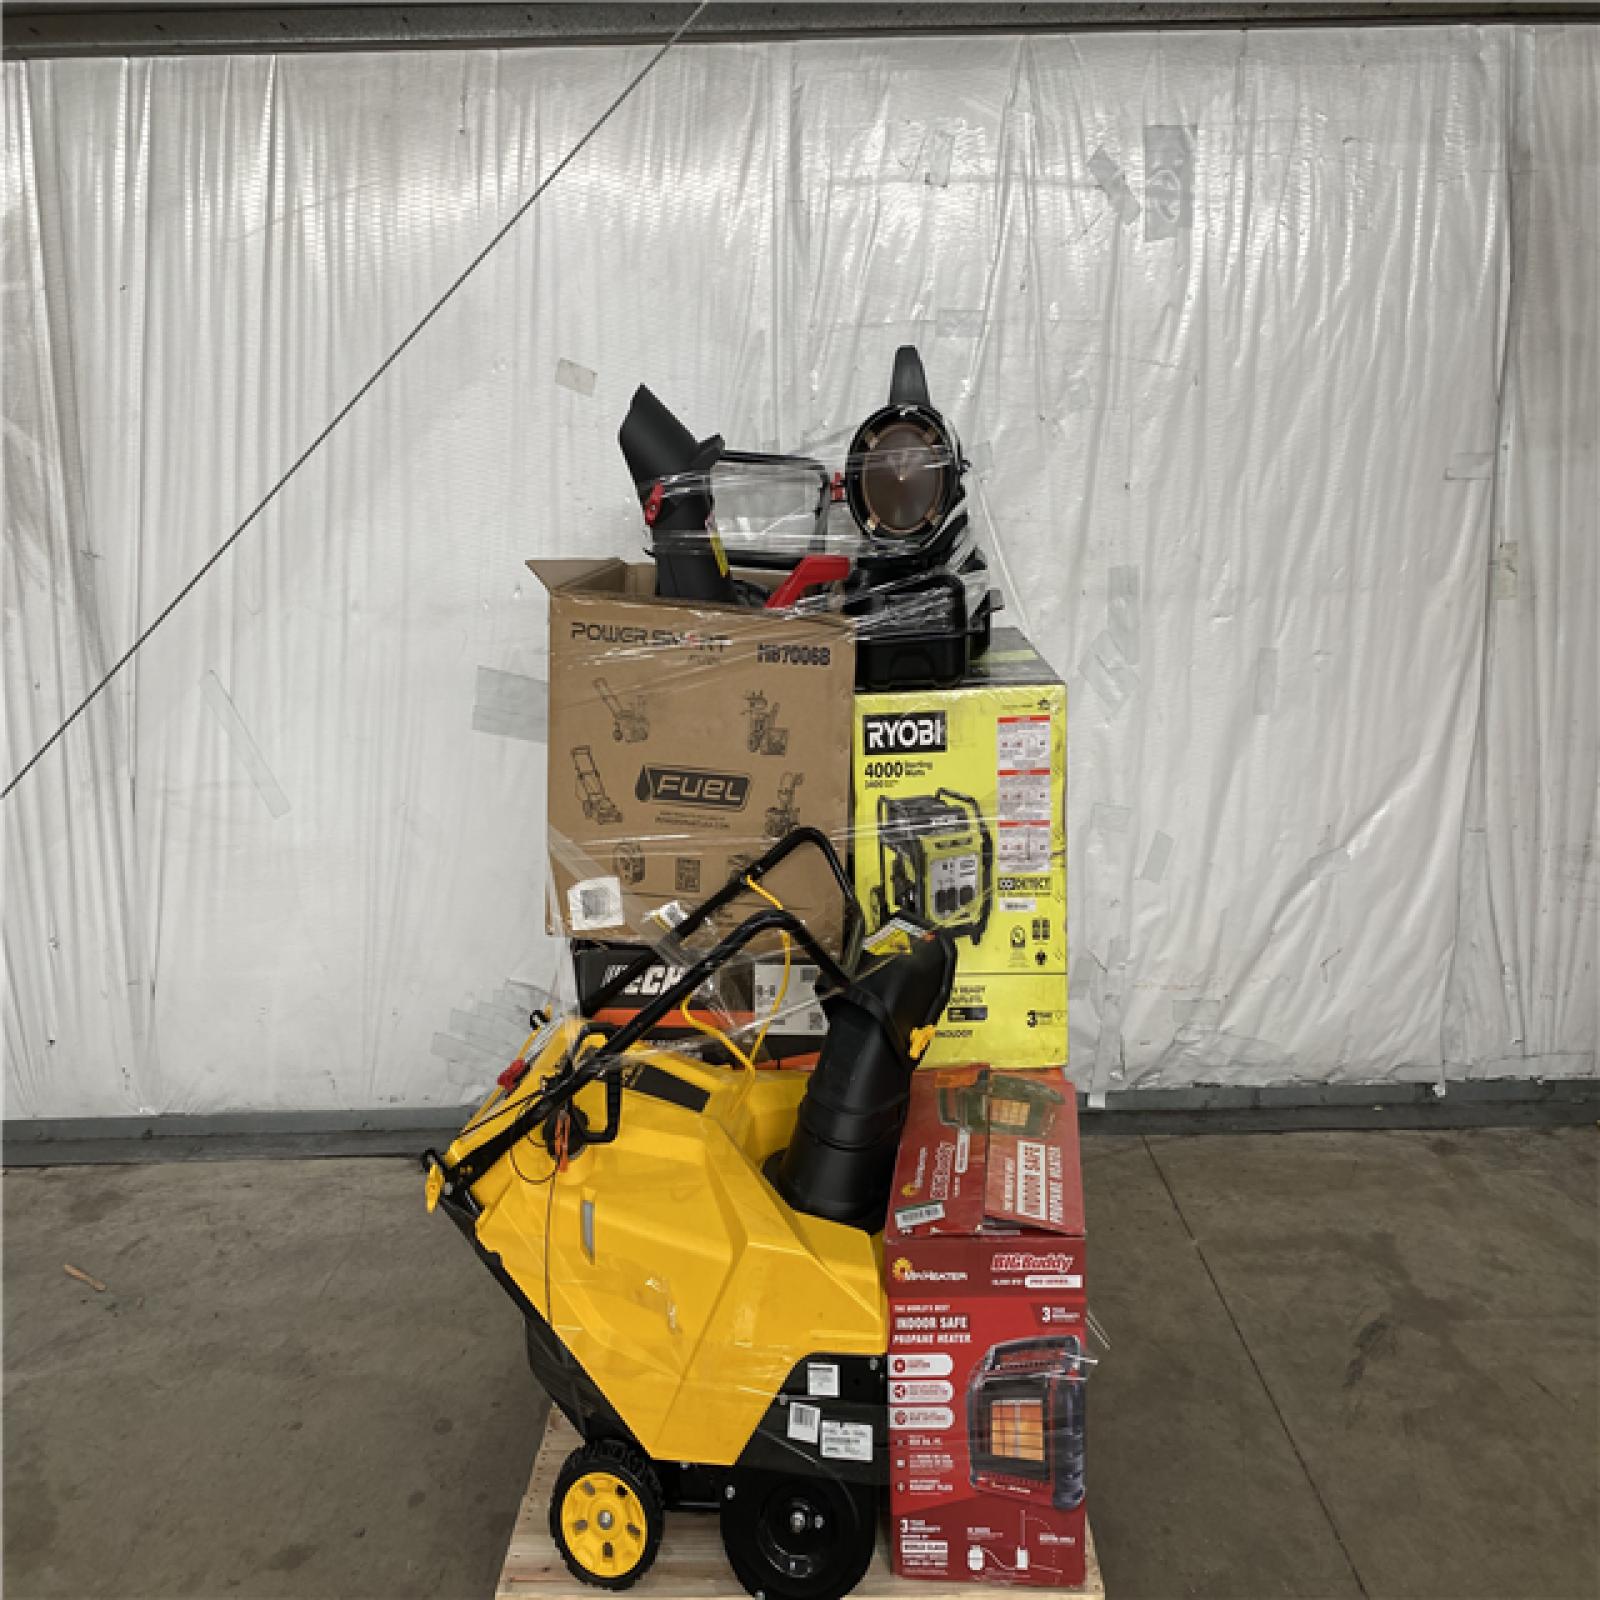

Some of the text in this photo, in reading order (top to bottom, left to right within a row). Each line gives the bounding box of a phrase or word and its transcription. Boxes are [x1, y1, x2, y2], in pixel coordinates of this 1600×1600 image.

[866, 719, 941, 749] RYOBI
[865, 761, 903, 778] 4000
[657, 774, 741, 801] FUEL
[1027, 1010, 1038, 1028] 3
[895, 1316, 968, 1330] INDOOR SAFE
[1041, 1306, 1051, 1323] 3
